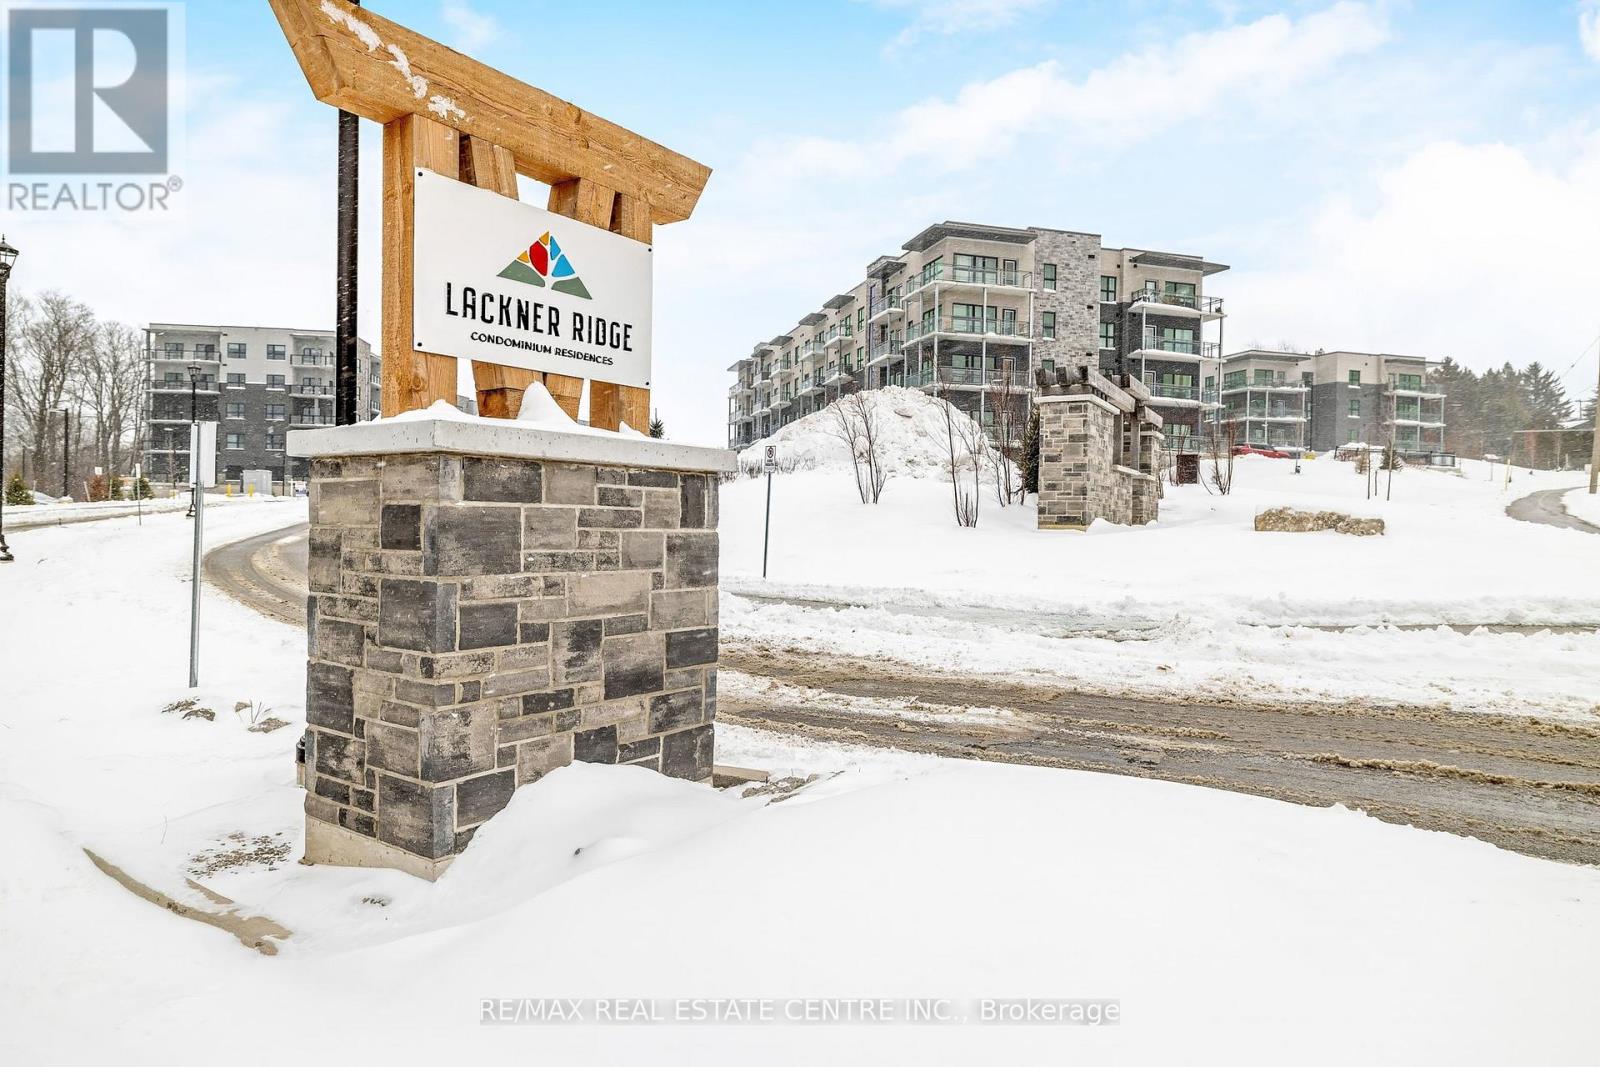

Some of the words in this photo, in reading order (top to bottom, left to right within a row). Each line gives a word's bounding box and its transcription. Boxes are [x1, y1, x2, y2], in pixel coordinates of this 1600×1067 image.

[446, 282, 560, 337] LACKNER
[572, 311, 633, 352] RIDGE
[470, 331, 552, 355] CONDOMINIUM
[555, 347, 614, 366] RESIDENCES
